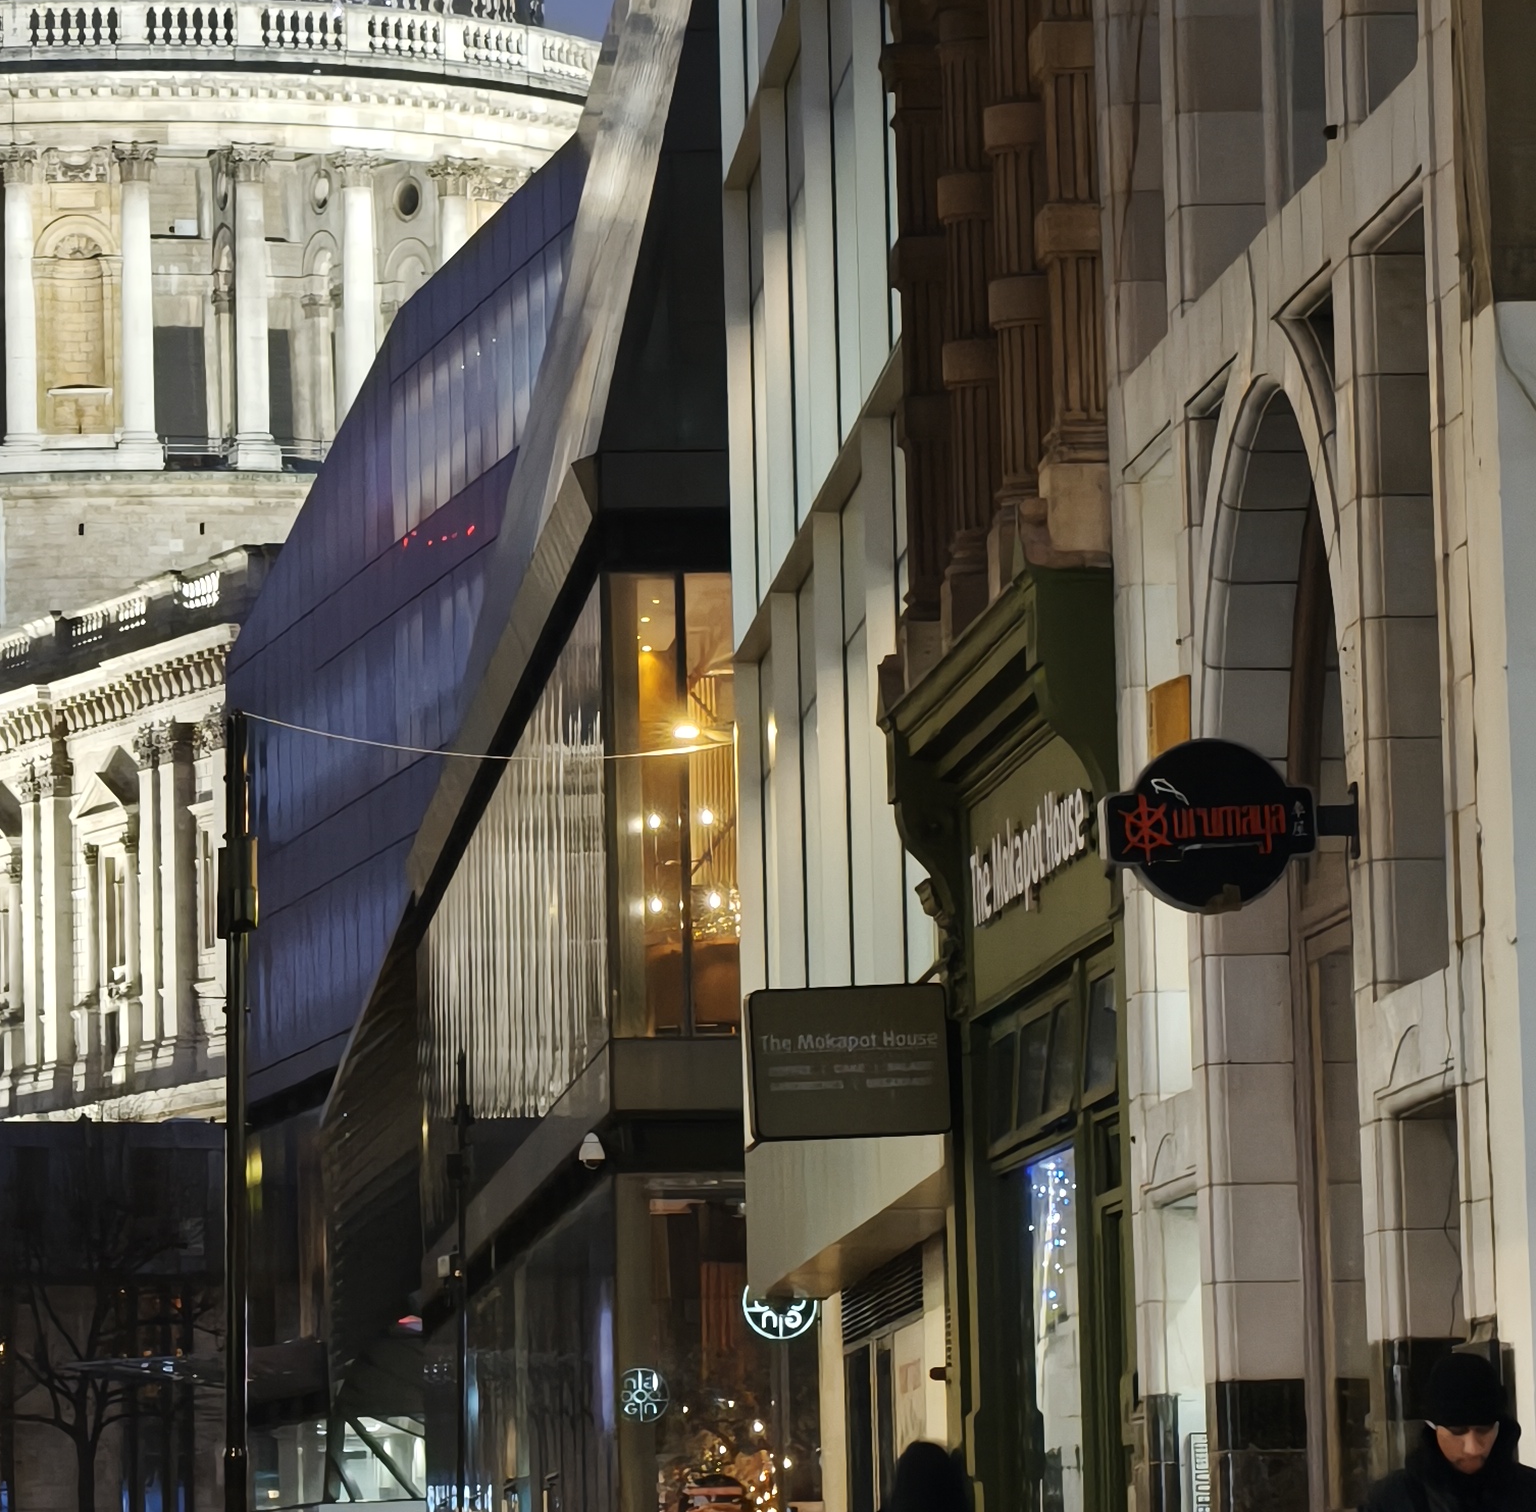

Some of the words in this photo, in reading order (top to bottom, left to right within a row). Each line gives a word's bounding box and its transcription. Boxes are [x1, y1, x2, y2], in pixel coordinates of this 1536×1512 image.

[970, 845, 992, 928] The
[991, 806, 1046, 912] Mokapot
[1044, 788, 1085, 873] House
[797, 1032, 877, 1052] Mokapot
[882, 1029, 938, 1047] House
